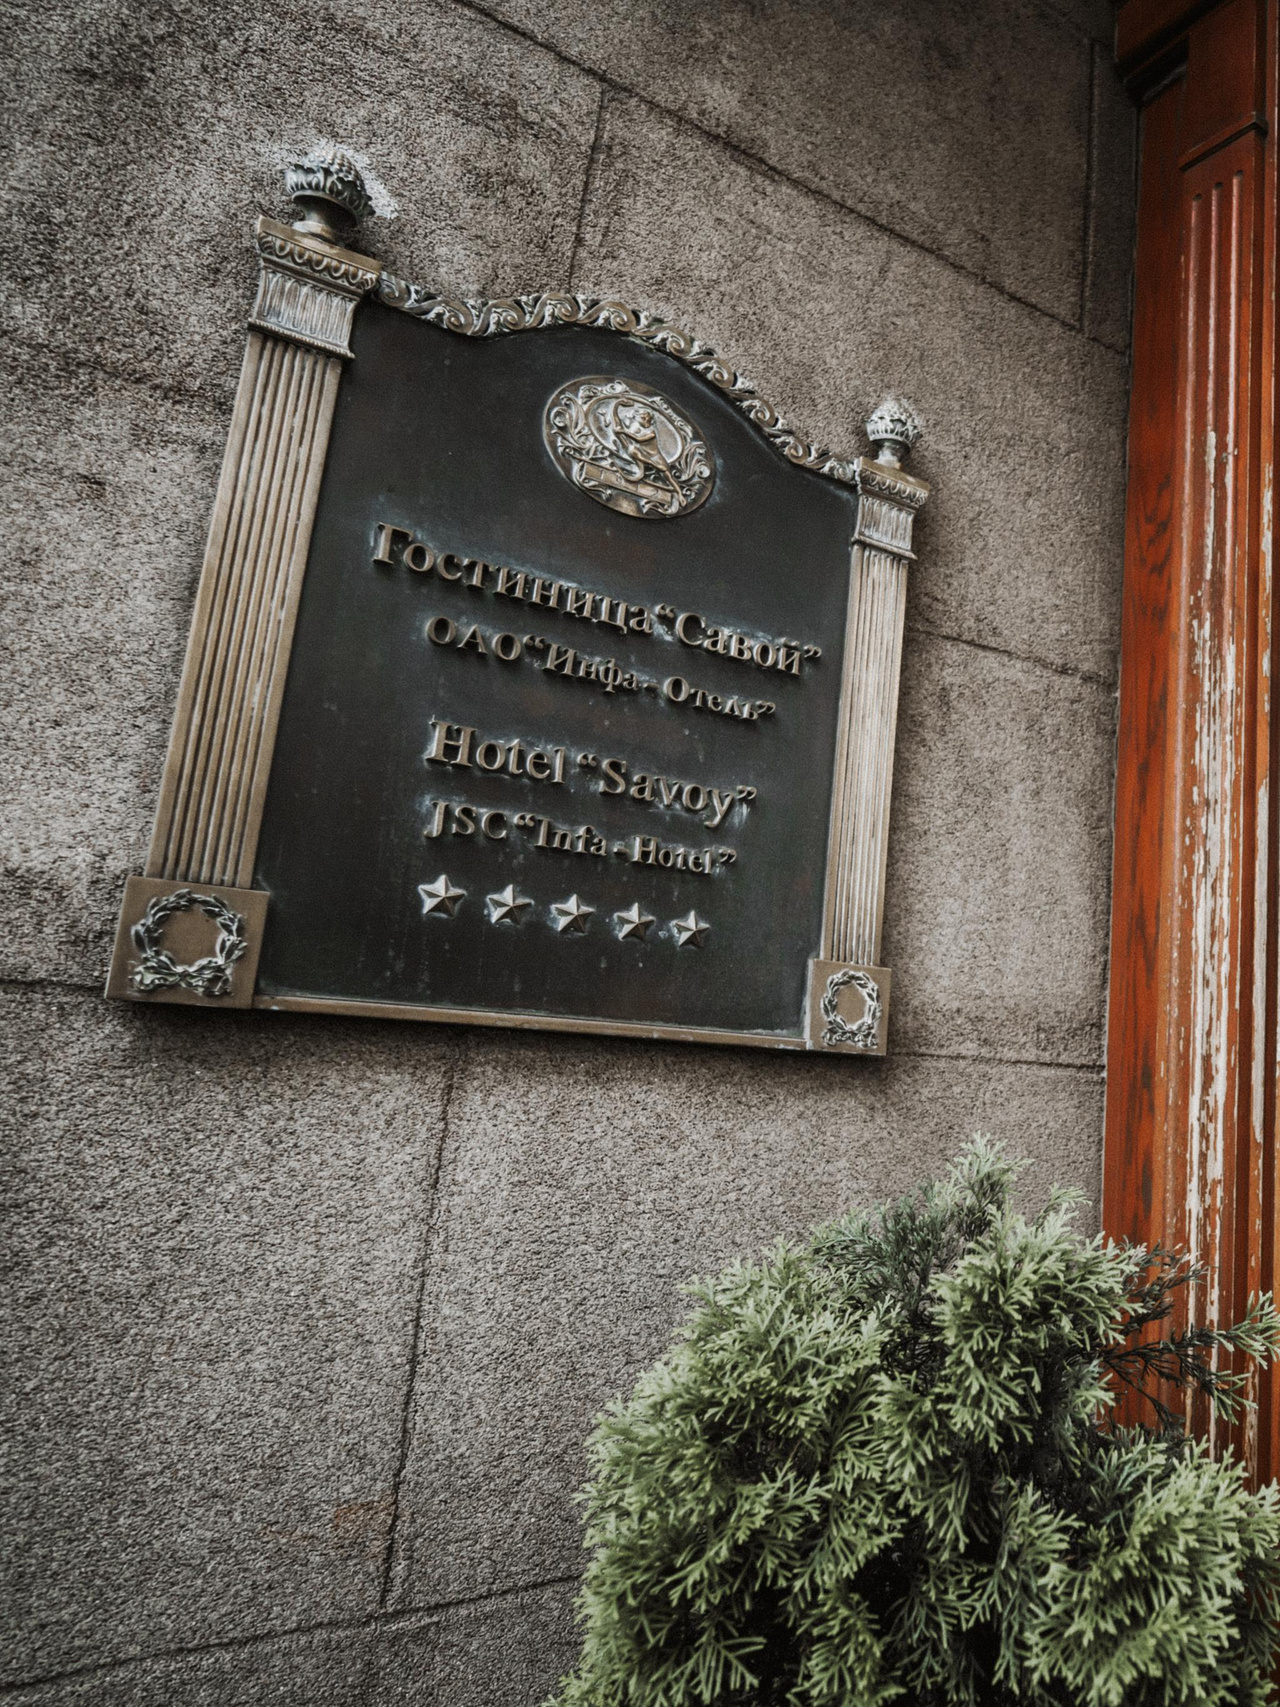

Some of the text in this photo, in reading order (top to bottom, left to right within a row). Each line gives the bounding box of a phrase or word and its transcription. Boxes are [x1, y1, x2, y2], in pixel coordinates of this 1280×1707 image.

[371, 521, 654, 635] Гостиница
[426, 616, 522, 662] ОАО
[425, 719, 567, 784] Hotel
[423, 800, 508, 840] JSC
